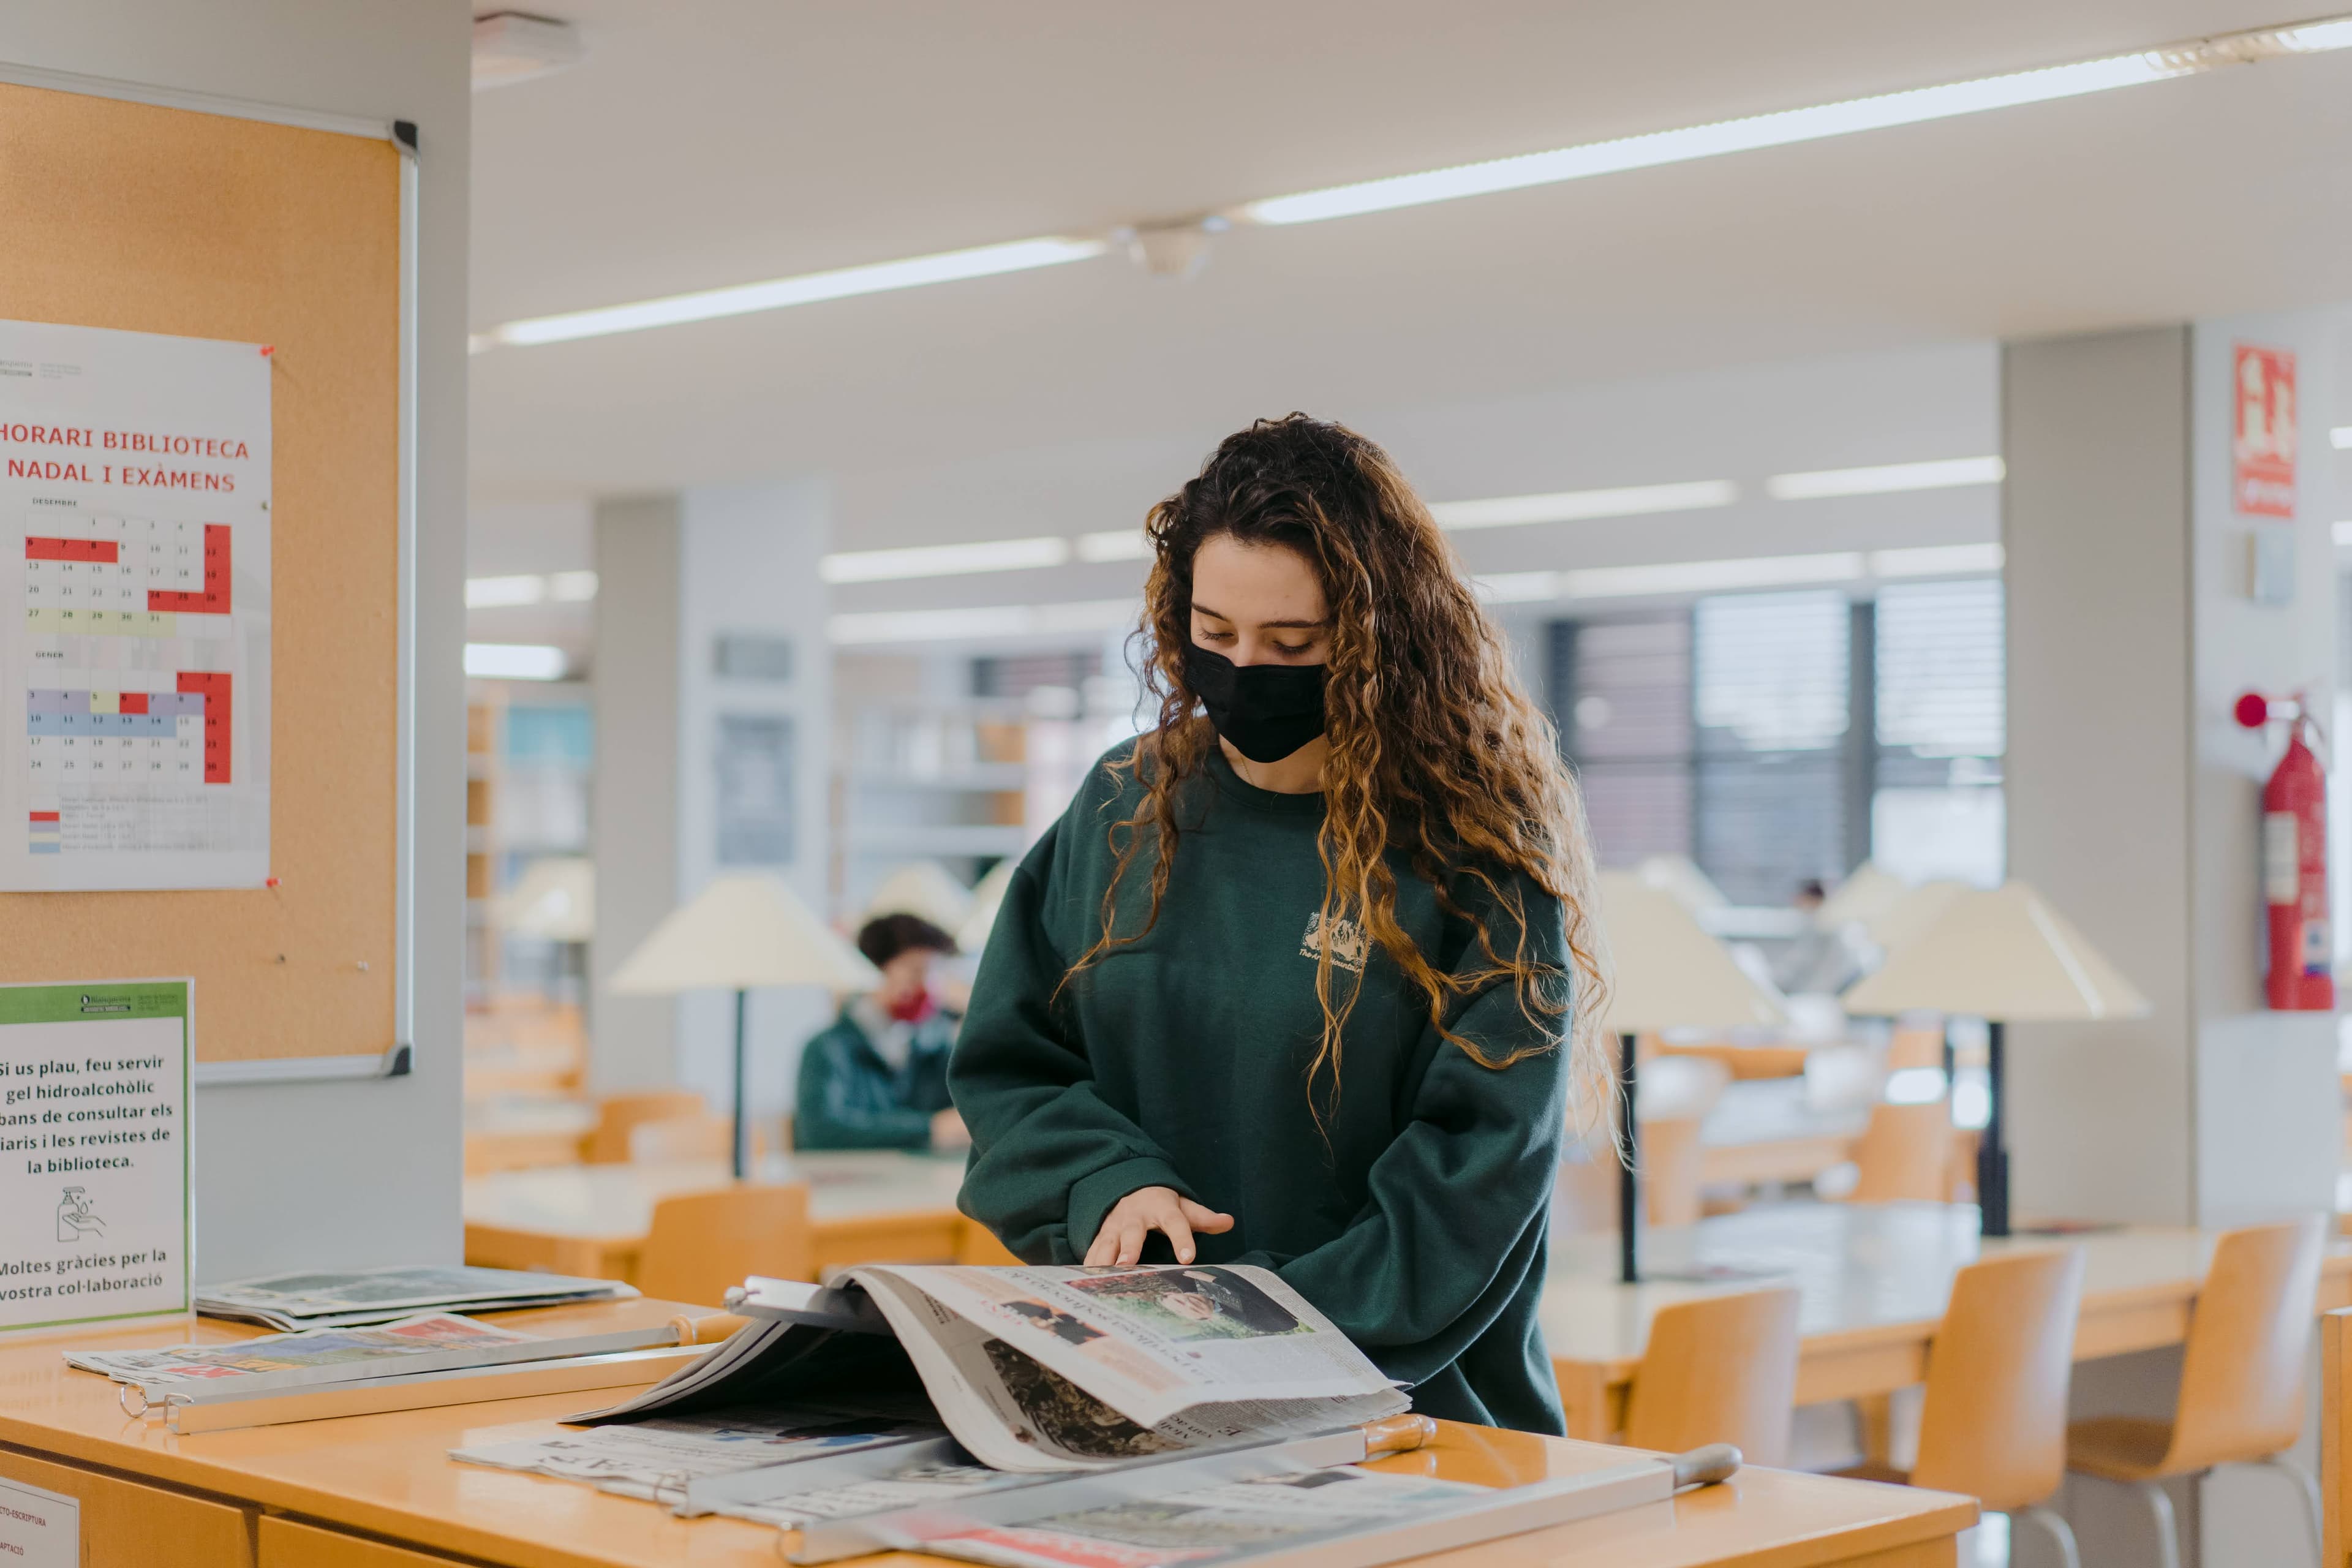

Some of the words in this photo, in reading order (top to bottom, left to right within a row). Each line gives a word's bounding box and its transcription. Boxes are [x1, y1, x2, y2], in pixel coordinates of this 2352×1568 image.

[0, 423, 92, 447] HORARI
[103, 431, 249, 460] BIBLIOTECA
[9, 459, 94, 482] NADAL
[104, 466, 112, 483] I
[123, 462, 235, 492] EXÀMENS
[32, 497, 77, 507] DESEMBRE
[0, 1061, 9, 1076] Si
[15, 1064, 34, 1076] us
[39, 1060, 80, 1078] plau,
[86, 1058, 111, 1072] feu
[117, 1055, 164, 1070] servir
[6, 1087, 31, 1104] gel
[37, 1079, 155, 1099] hidroalcohòlic
[43, 1109, 62, 1123] de
[67, 1106, 146, 1122] consultar
[151, 1103, 172, 1117] els
[42, 1134, 47, 1148] i
[53, 1134, 75, 1148] les
[81, 1130, 146, 1145] revistes
[152, 1128, 170, 1141] de
[28, 1160, 42, 1174] la
[48, 1156, 134, 1173] biblioteca.
[0, 1259, 51, 1276] Moltes
[57, 1254, 116, 1275] gràcies
[122, 1254, 147, 1268] per
[153, 1248, 167, 1262] la
[0, 1285, 52, 1301] vostra
